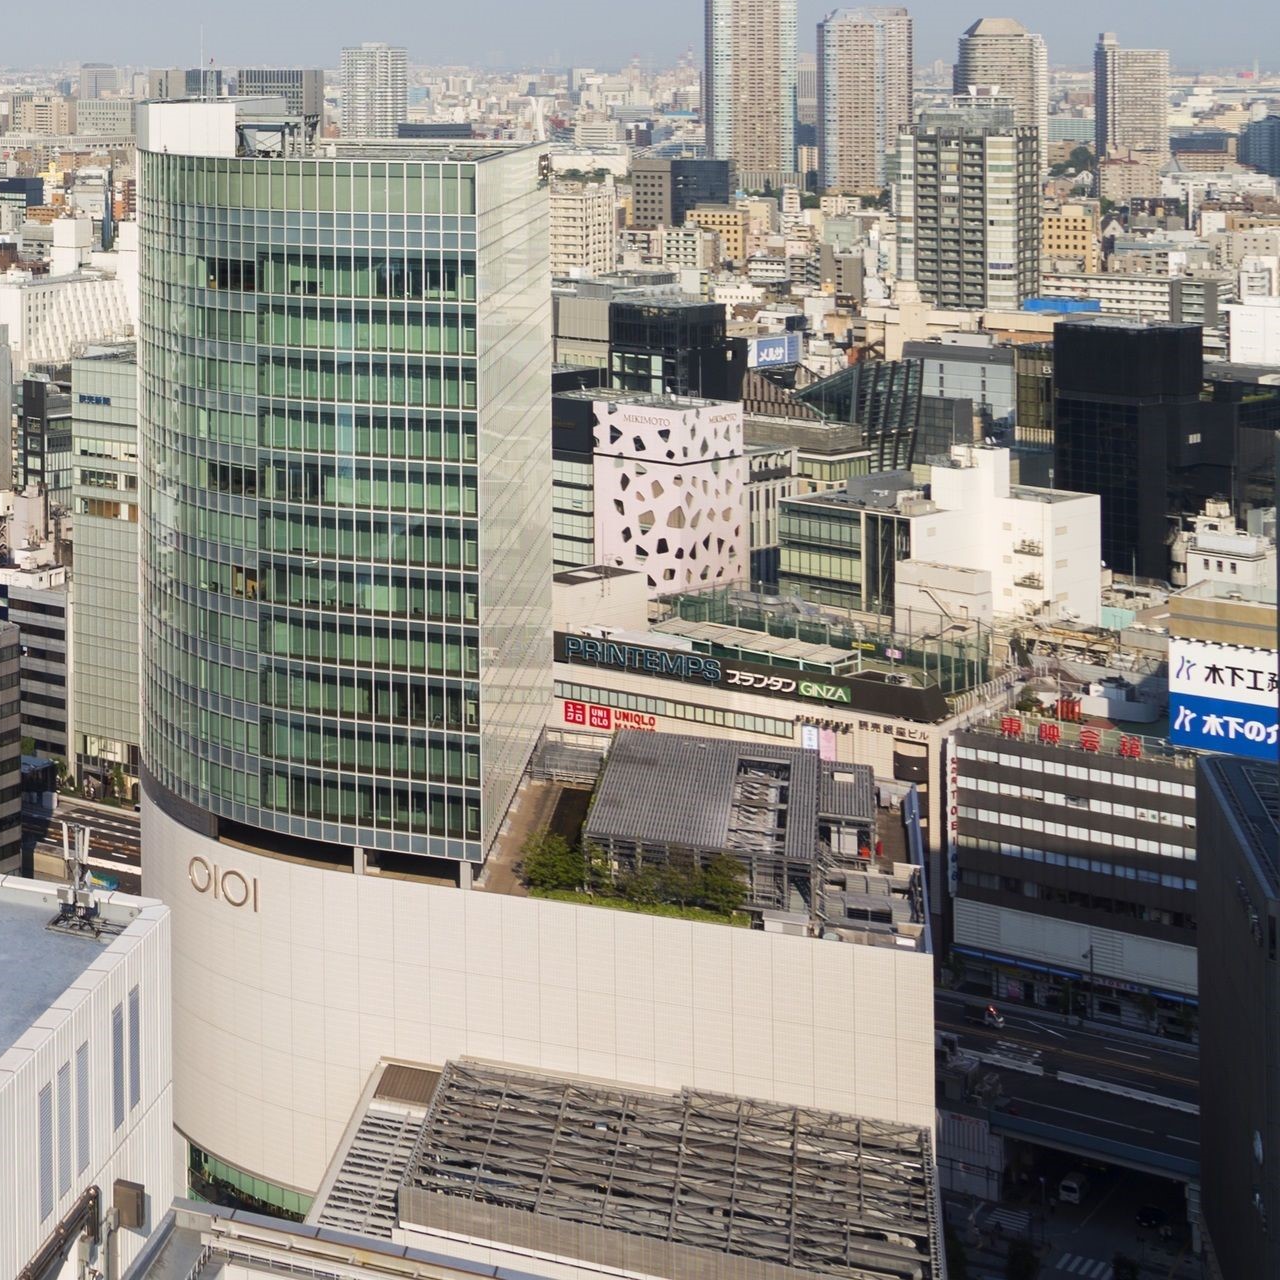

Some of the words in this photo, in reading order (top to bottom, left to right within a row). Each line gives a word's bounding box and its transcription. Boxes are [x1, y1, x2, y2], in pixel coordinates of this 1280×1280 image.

[758, 347, 784, 362] メルサ
[623, 413, 671, 427] MIKIMOTO
[708, 412, 737, 424] MIKIMOTO
[565, 636, 721, 682] PRINTEMPS
[726, 669, 796, 693] プランタン
[800, 681, 847, 700] GINZA
[591, 708, 607, 717] UNI
[614, 710, 656, 727] UNIQLO
[591, 716, 609, 726] QLO
[1001, 716, 1142, 758] 東映会館
